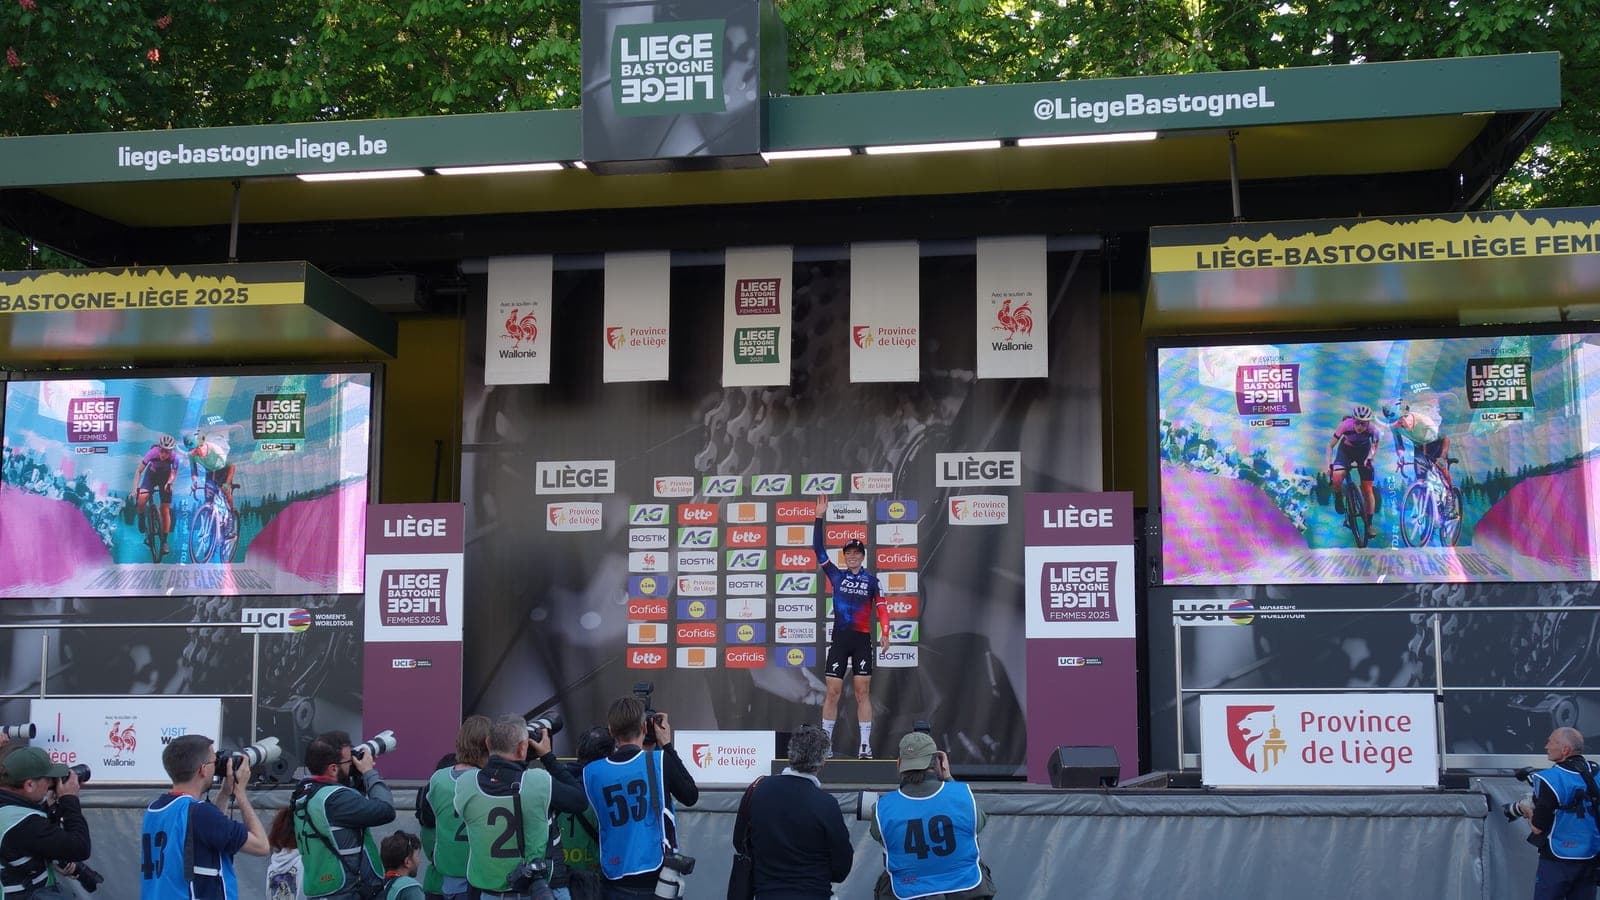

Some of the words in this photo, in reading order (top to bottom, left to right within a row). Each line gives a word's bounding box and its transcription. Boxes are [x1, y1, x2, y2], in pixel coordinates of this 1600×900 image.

[621, 33, 713, 62] LIEGE
[621, 60, 713, 76] BASTOGNE
[621, 75, 713, 103] LIEGE
[1033, 86, 1274, 122] @LiegeBastogneL
[118, 135, 388, 171] liege-bastogne-liege.be
[1197, 235, 1526, 270] LIÈGE-BASTOGNE-LIÈGE
[1535, 234, 1600, 254] FEM
[741, 282, 776, 292] LIEGE
[196, 288, 249, 305] 2025
[740, 297, 776, 307] LIEGE
[630, 327, 666, 336] Province
[740, 331, 775, 340] LIEGE
[878, 327, 916, 335] Province
[630, 338, 640, 346] de
[643, 338, 666, 348] Liège
[878, 338, 890, 346] de
[892, 338, 916, 348] Liège
[992, 342, 1032, 351] Wallonie
[499, 349, 536, 358] Wallonie
[1244, 369, 1293, 382] LIEGE
[1471, 364, 1526, 379] LIEGE
[1244, 382, 1293, 390] BASTOGNE
[1472, 379, 1527, 387] BASTOGNE
[1244, 390, 1293, 403] LIEGE
[1472, 387, 1527, 401] LIEGE
[74, 401, 114, 413] LIEGE
[257, 400, 300, 413] LIEGE
[73, 420, 114, 432] LIEGE
[256, 420, 300, 433] LIEGE
[943, 456, 1014, 481] LIÈGE
[542, 465, 608, 488] LIÈGE
[706, 478, 736, 494] AG
[755, 478, 785, 492] AG
[804, 477, 835, 491] AG
[973, 501, 1006, 509] Province
[569, 508, 600, 516] Province
[633, 507, 663, 521] AG
[777, 507, 815, 516] Cofidis
[983, 510, 1006, 519] Liège
[1043, 504, 1113, 528] LIÈGE
[384, 514, 446, 538] LIÈGE
[579, 517, 600, 526] Liège
[631, 534, 666, 542] BOSTIK
[681, 530, 712, 545] AG
[827, 530, 866, 539] Cofidis
[680, 558, 715, 566] BOSTIK
[731, 553, 760, 567] AG
[877, 554, 917, 563] Cofidis
[388, 573, 440, 589] LIEGE
[1050, 567, 1109, 583] LIEGE
[780, 577, 811, 591] AG
[841, 579, 859, 588] FDJ
[1050, 583, 1109, 592] BASTOGNE
[388, 589, 440, 598] BASTOGNE
[387, 598, 440, 613] LIEGE
[1050, 592, 1109, 608] LIEGE
[629, 605, 667, 614] Cofidis
[886, 602, 912, 613] otto
[1179, 604, 1223, 621] UCI
[247, 613, 284, 628] UCI
[386, 616, 419, 624] FEMMES
[1088, 611, 1110, 619] 2025
[678, 629, 716, 638] Cofidis
[727, 653, 765, 661] Cofidis
[879, 651, 915, 660] BOSTIK
[1301, 709, 1411, 732] Province
[161, 727, 187, 736] VISIT
[48, 748, 77, 763] iège
[718, 746, 756, 754] Province
[103, 758, 135, 766] Wallonie
[718, 757, 730, 765] de
[731, 757, 756, 768] Liège
[1302, 741, 1334, 764] de
[1342, 740, 1413, 773] Liège
[602, 779, 647, 827] 53
[904, 815, 956, 860] 49
[141, 831, 168, 880] 43
